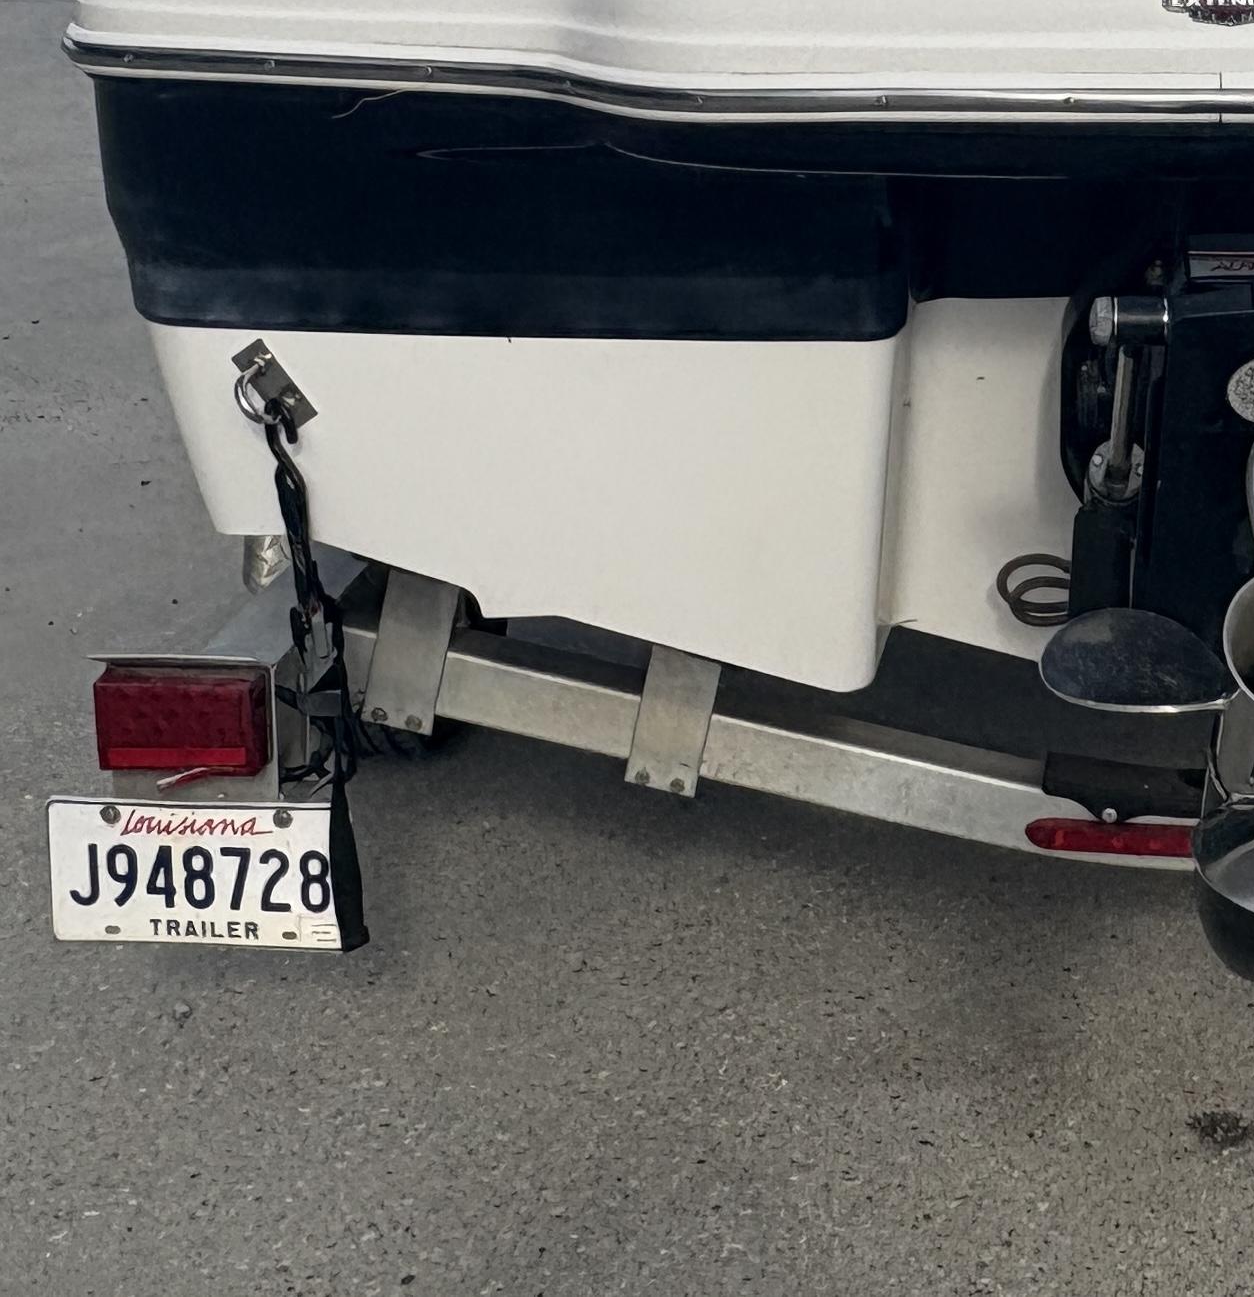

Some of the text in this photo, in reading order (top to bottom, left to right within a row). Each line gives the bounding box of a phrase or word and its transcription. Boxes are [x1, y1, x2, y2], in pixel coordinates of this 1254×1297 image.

[120, 809, 274, 837] Louisiana
[69, 843, 331, 914] J948728
[149, 918, 260, 940] TRAILER
